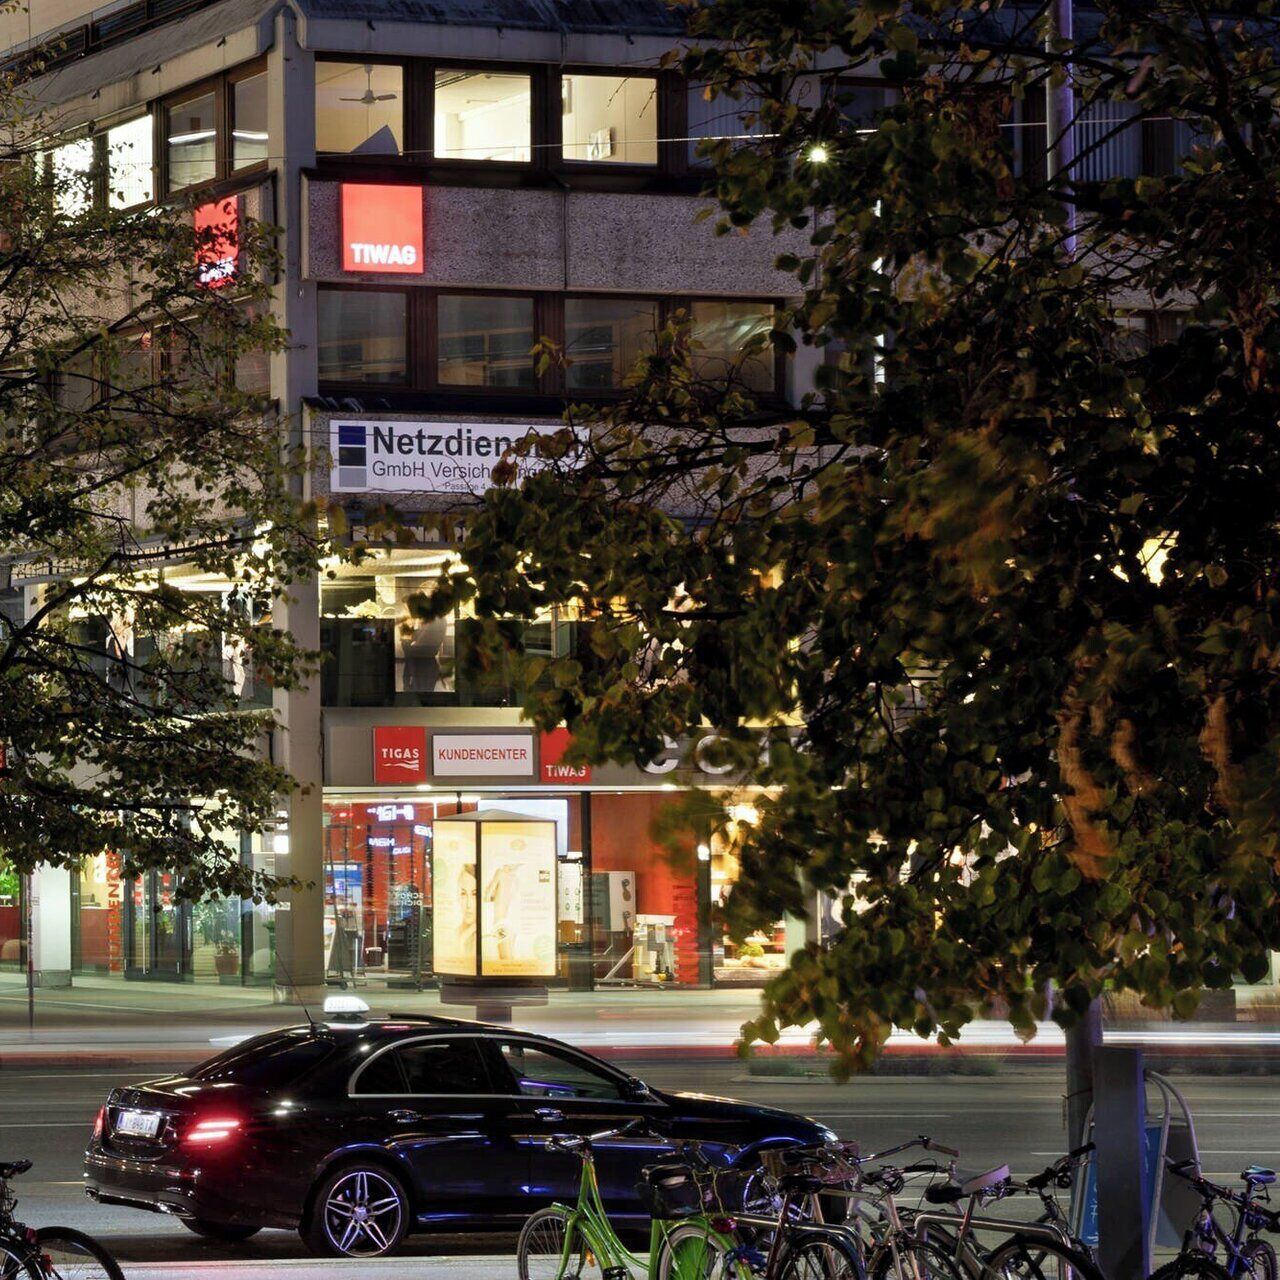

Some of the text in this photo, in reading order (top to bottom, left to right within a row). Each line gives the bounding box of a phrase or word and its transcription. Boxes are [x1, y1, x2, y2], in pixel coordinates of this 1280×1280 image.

[351, 243, 416, 266] TIWAG
[373, 461, 425, 477] GmbH
[382, 748, 419, 759] TIGAS
[439, 748, 527, 761] KUNDENCENTER
[545, 764, 587, 778] TIWAG
